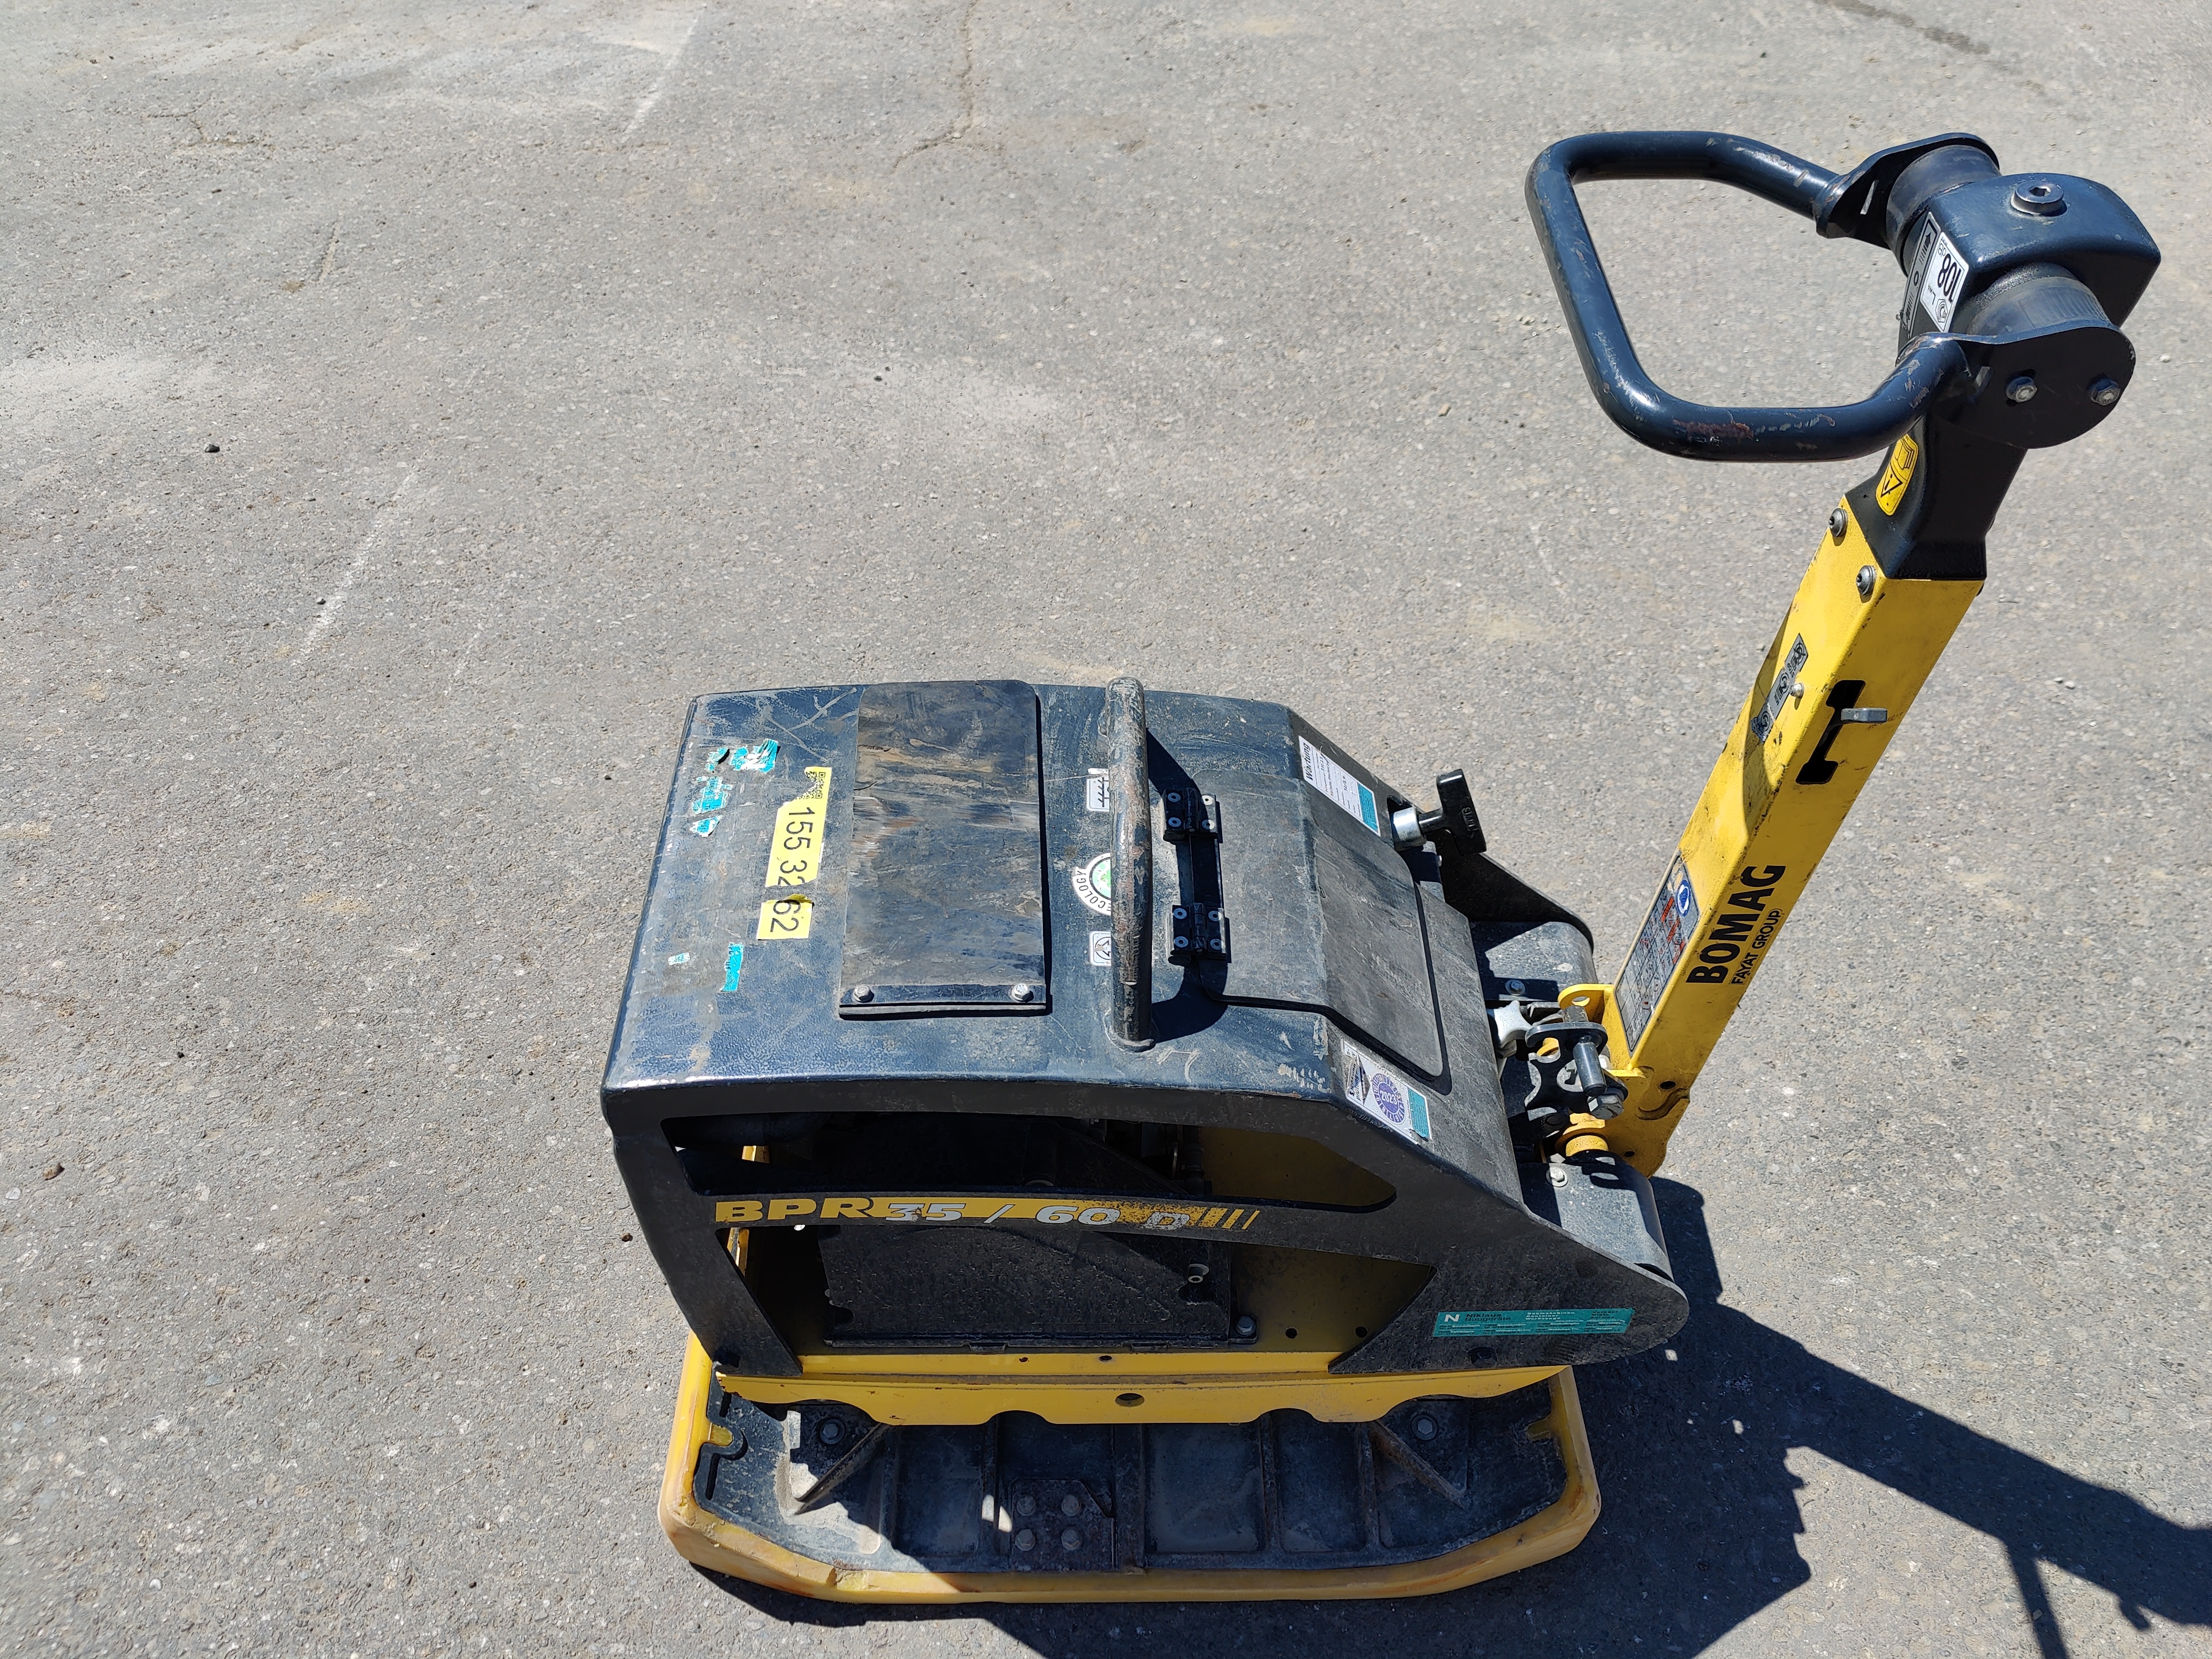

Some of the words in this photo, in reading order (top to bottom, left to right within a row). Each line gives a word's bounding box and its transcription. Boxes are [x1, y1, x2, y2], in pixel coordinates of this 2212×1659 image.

[1938, 243, 1946, 257] dB
[1937, 253, 1962, 304] 108
[1303, 742, 1313, 781] Wartung
[784, 807, 816, 851] 155
[770, 899, 801, 932] 62
[1686, 865, 1786, 983] BOMAG
[1731, 952, 1759, 984] FAYAT
[1752, 910, 1781, 949] GROUP
[1380, 1090, 1397, 1105] 2023
[715, 1197, 870, 1223] BPR
[885, 1203, 966, 1222] 35
[1036, 1205, 1121, 1226] 60
[1444, 1314, 1460, 1322] N
